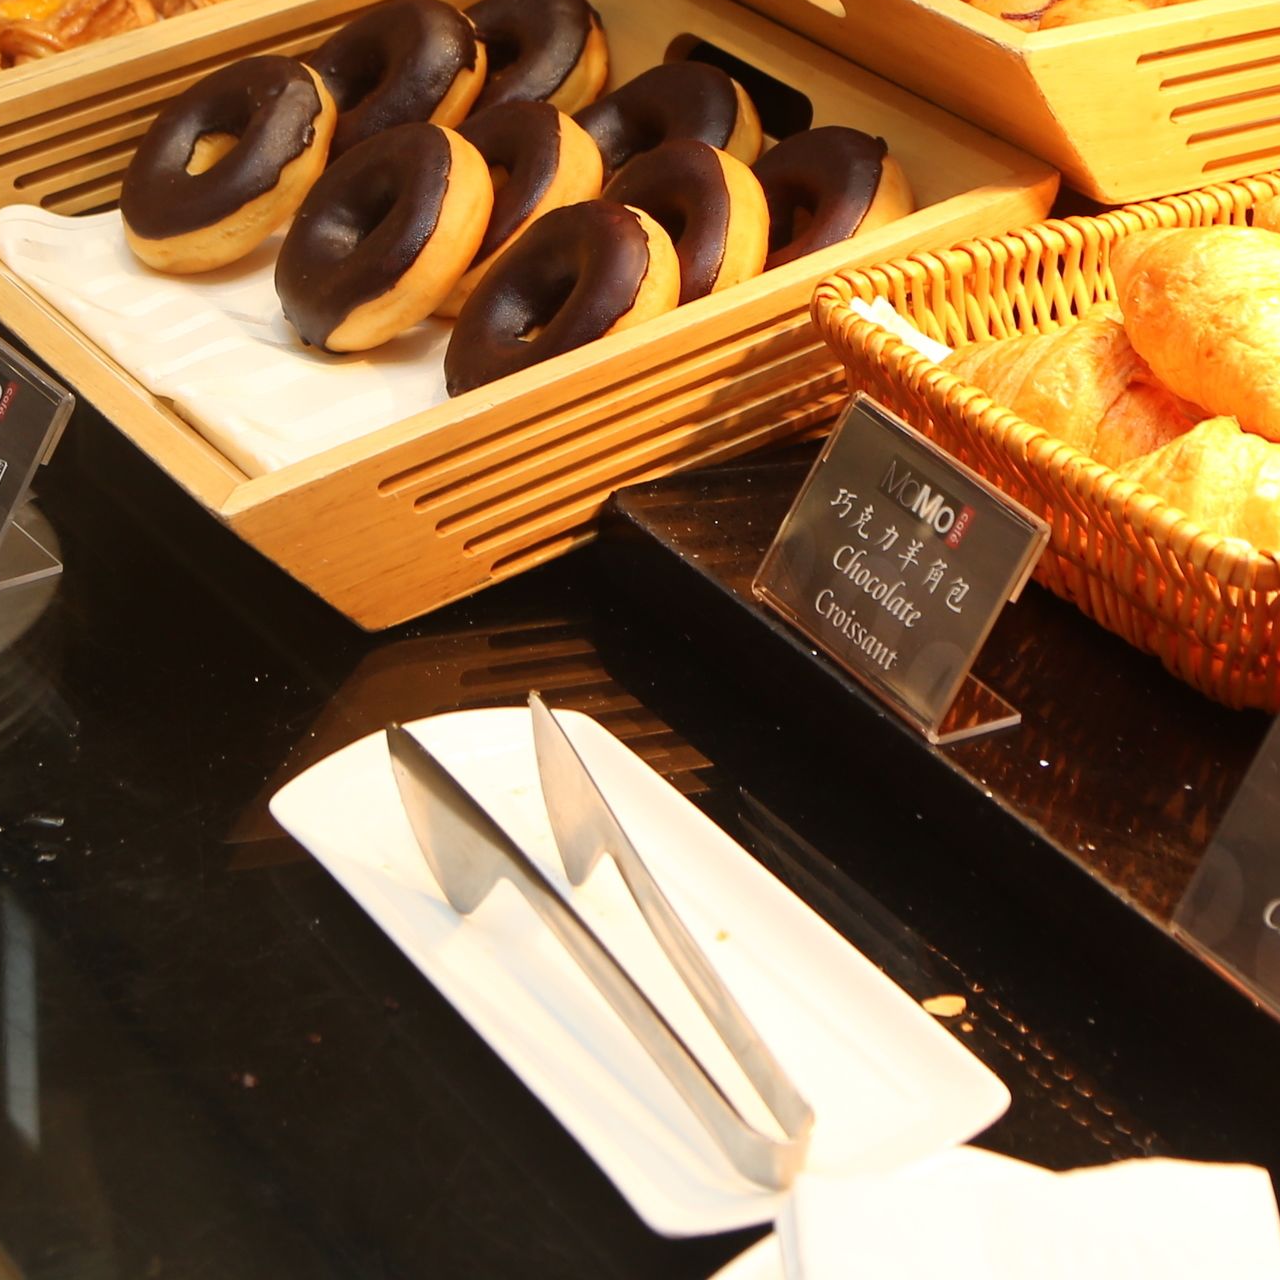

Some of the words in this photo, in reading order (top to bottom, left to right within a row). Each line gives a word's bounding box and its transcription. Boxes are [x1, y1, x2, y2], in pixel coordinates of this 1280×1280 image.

[830, 487, 972, 614] 巧克力羊角包
[832, 544, 922, 629] Chocolate
[815, 588, 899, 671] Croissant
